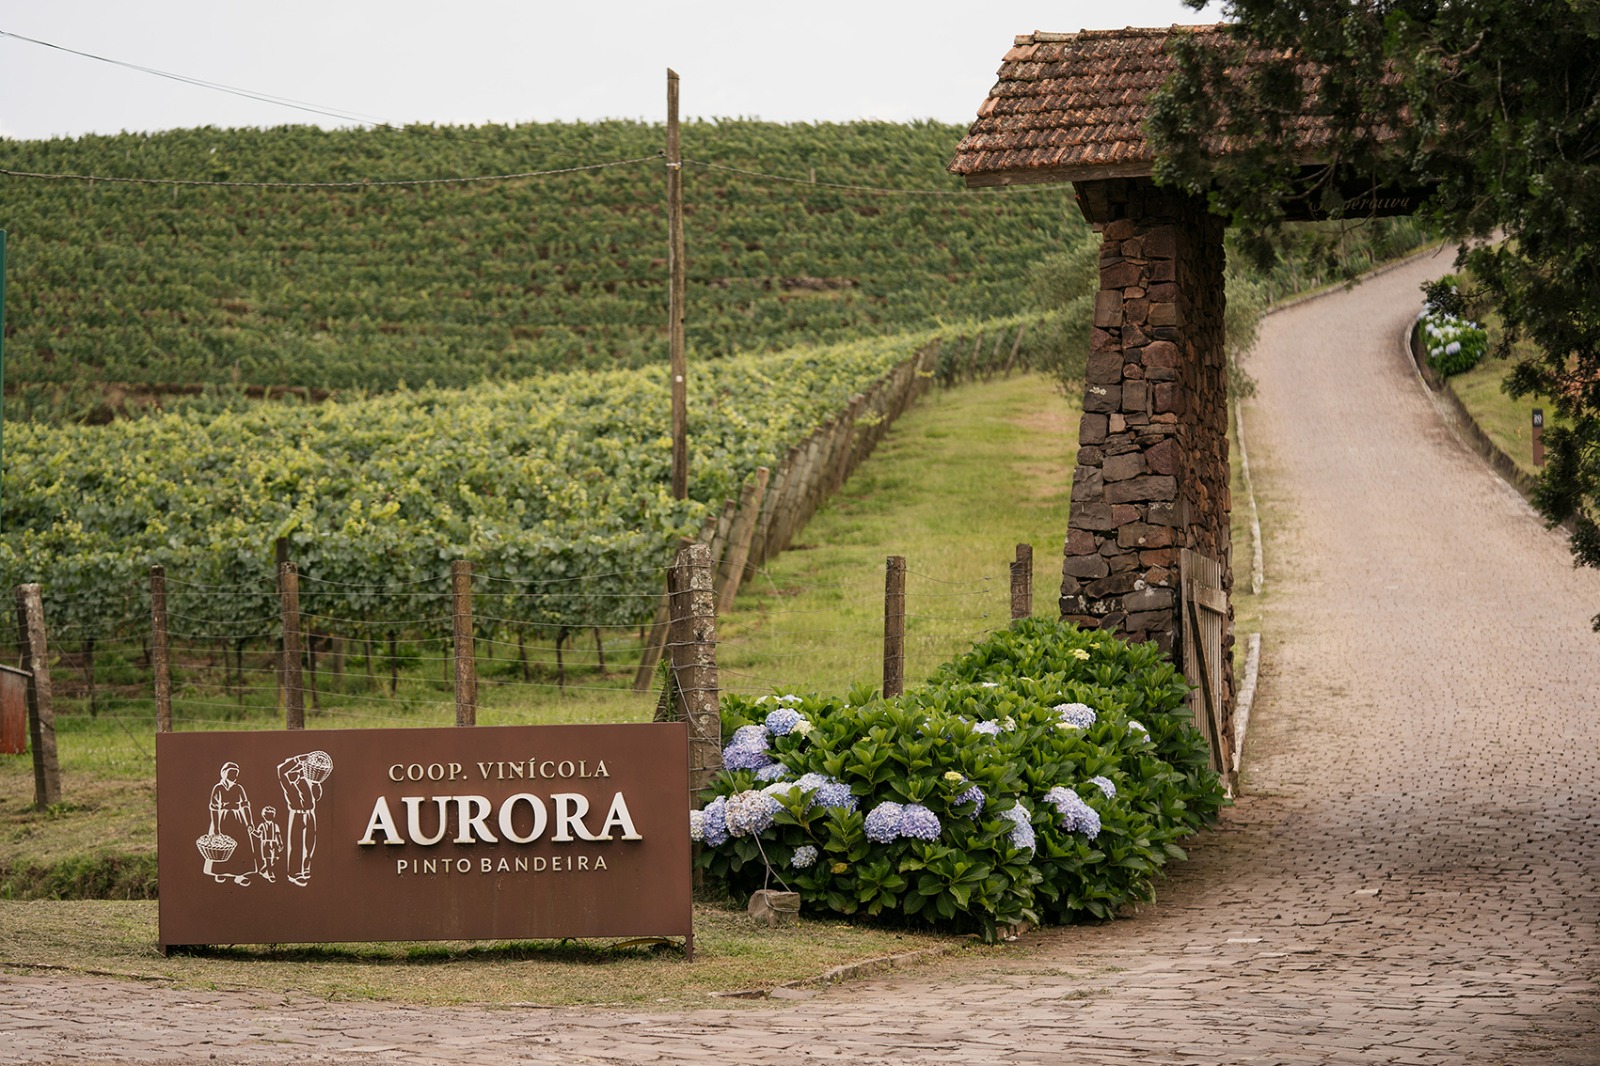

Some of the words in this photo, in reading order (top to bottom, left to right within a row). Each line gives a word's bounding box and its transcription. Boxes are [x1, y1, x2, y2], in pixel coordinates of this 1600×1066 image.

[388, 762, 468, 782] COOP.
[477, 757, 611, 780] VINÍCOLA
[357, 791, 643, 846] AURORA
[397, 857, 472, 875] PINTO
[480, 855, 608, 873] BANDEIRA
